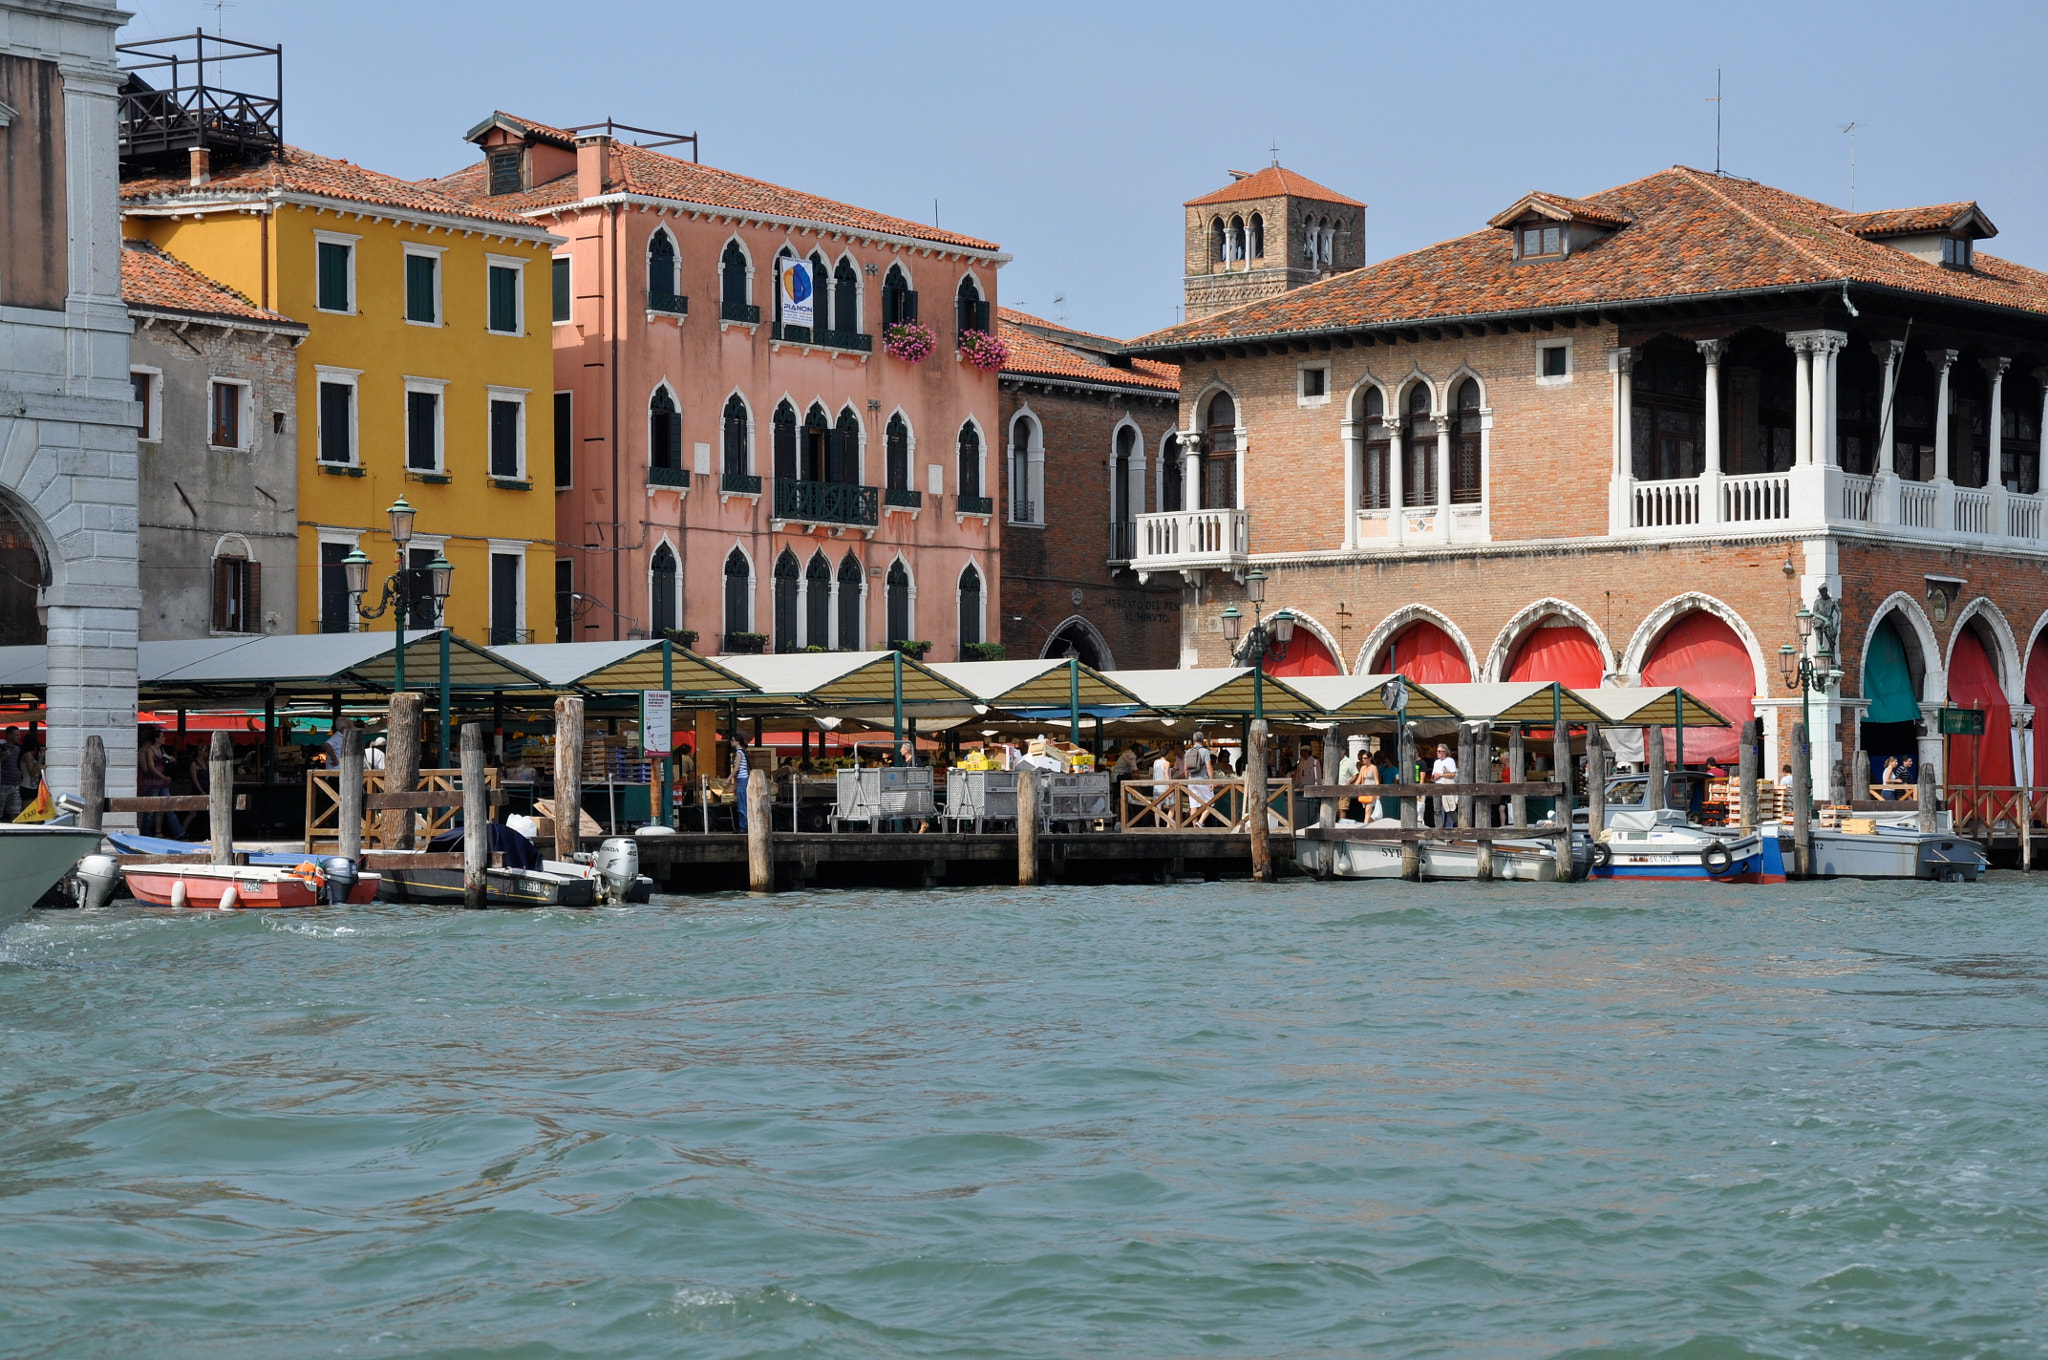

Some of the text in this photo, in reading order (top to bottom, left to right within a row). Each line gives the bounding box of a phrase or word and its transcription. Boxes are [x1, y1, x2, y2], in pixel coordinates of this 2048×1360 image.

[784, 303, 813, 313] PIANON
[1103, 598, 1181, 611] MERCATO DEL PES
[1123, 612, 1134, 621] AL
[23, 809, 37, 820] TAXI
